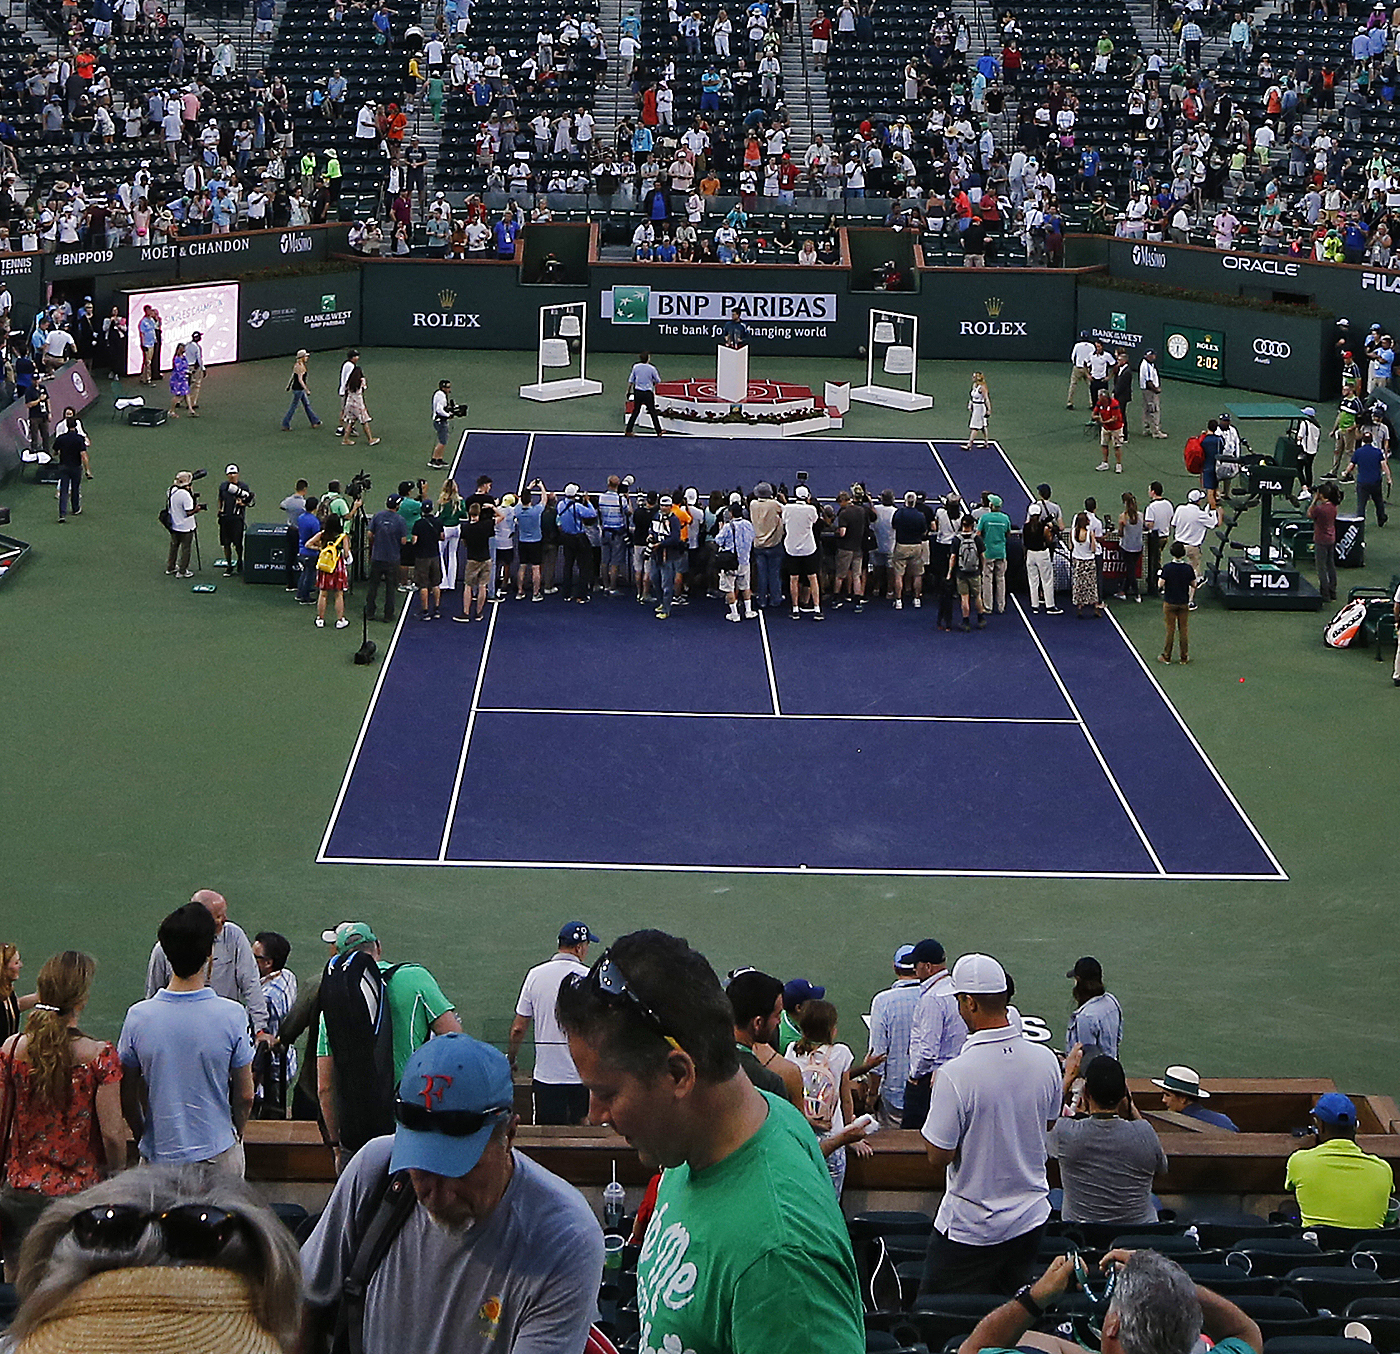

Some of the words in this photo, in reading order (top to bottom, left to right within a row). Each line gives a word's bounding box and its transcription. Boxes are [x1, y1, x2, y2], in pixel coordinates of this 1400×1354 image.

[179, 246, 186, 257] &
[188, 238, 251, 256] CHANDON
[0, 257, 32, 270] TENNIS
[1222, 255, 1299, 277] ORACLE
[658, 294, 710, 315] BNP
[721, 295, 827, 318] PARIBAS
[304, 313, 325, 324] BANK
[330, 310, 352, 321] WEST
[412, 313, 481, 327] ROLEX
[658, 324, 679, 335] The
[682, 324, 708, 336] bank
[749, 326, 792, 339] hanging
[794, 326, 827, 338] world
[959, 321, 1028, 336] ROLEX
[1092, 328, 1114, 339] BANK
[1120, 332, 1144, 343] WEST
[1196, 354, 1219, 371] 2:02
[1258, 480, 1282, 491] FILA
[1250, 574, 1290, 589] FILA
